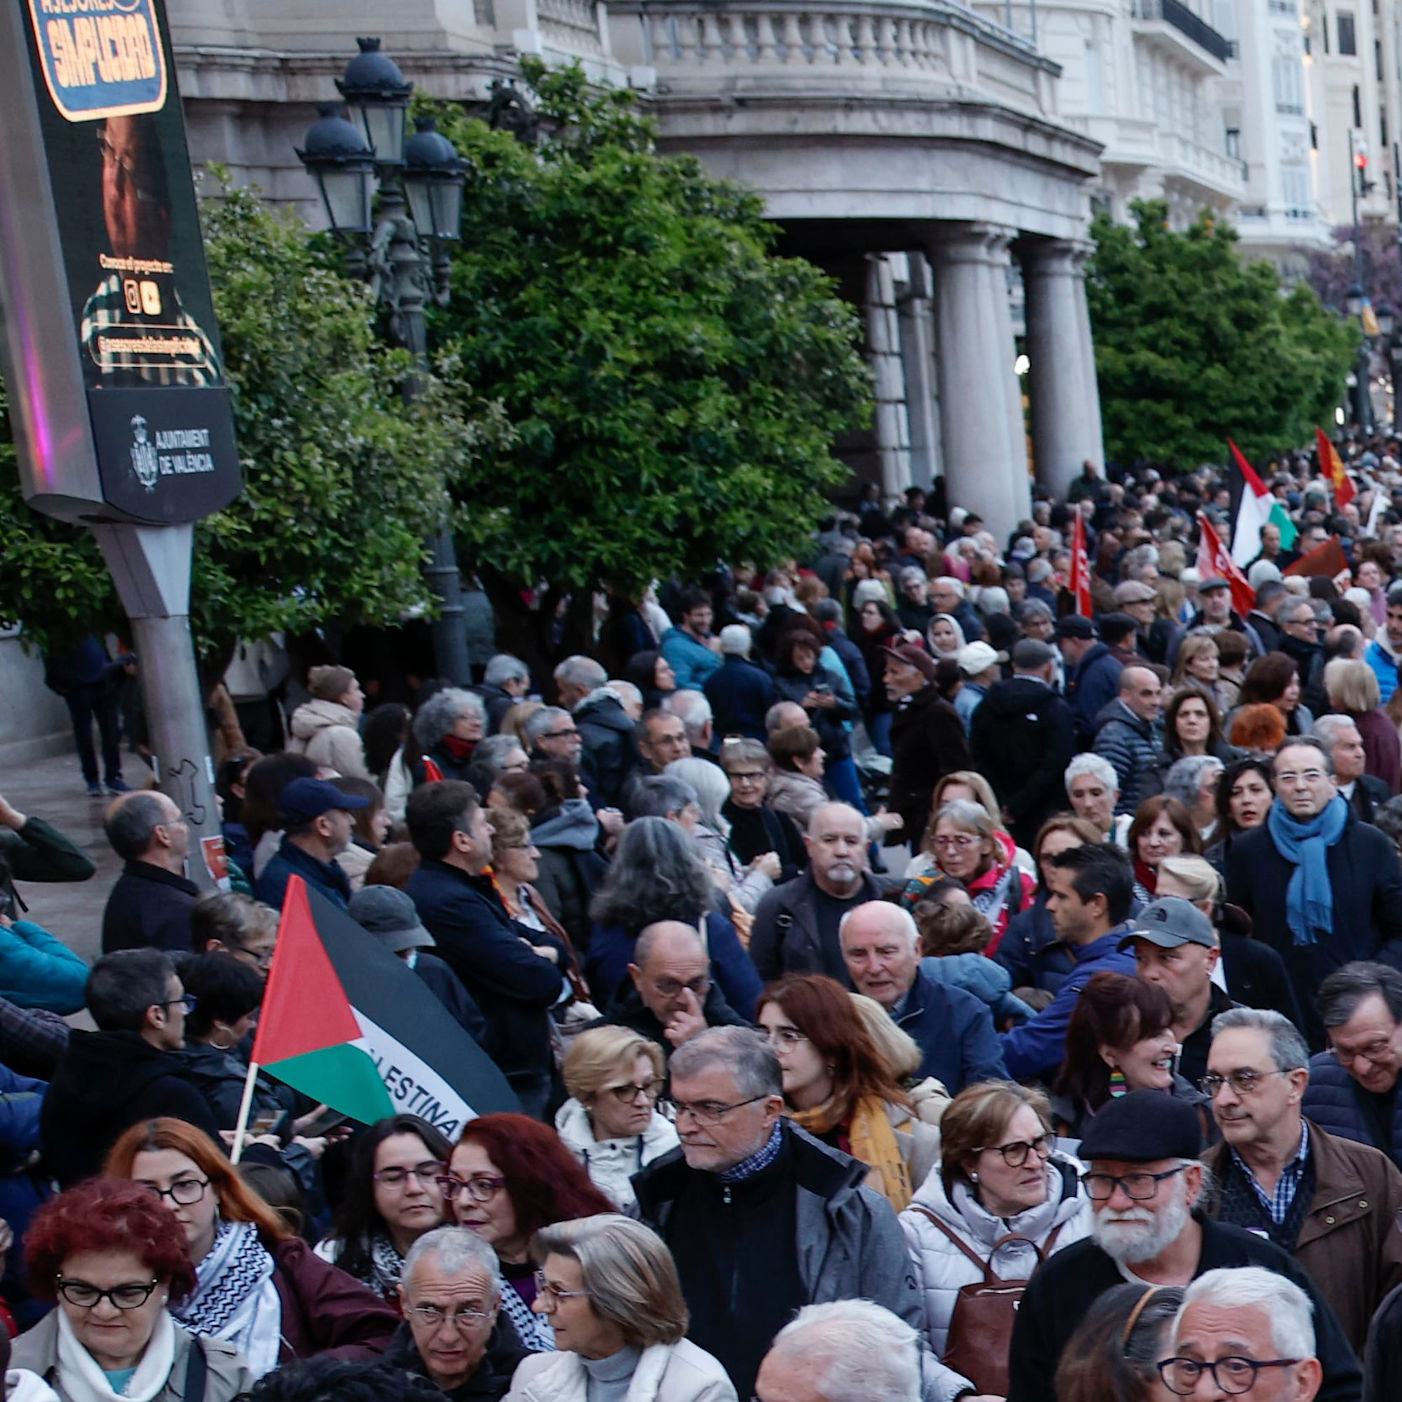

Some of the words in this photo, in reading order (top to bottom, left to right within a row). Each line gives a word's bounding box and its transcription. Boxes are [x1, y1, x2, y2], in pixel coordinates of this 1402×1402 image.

[156, 428, 210, 450] AJUNTAMENT
[158, 455, 174, 475] DE
[171, 450, 215, 473] VALÈNCIA
